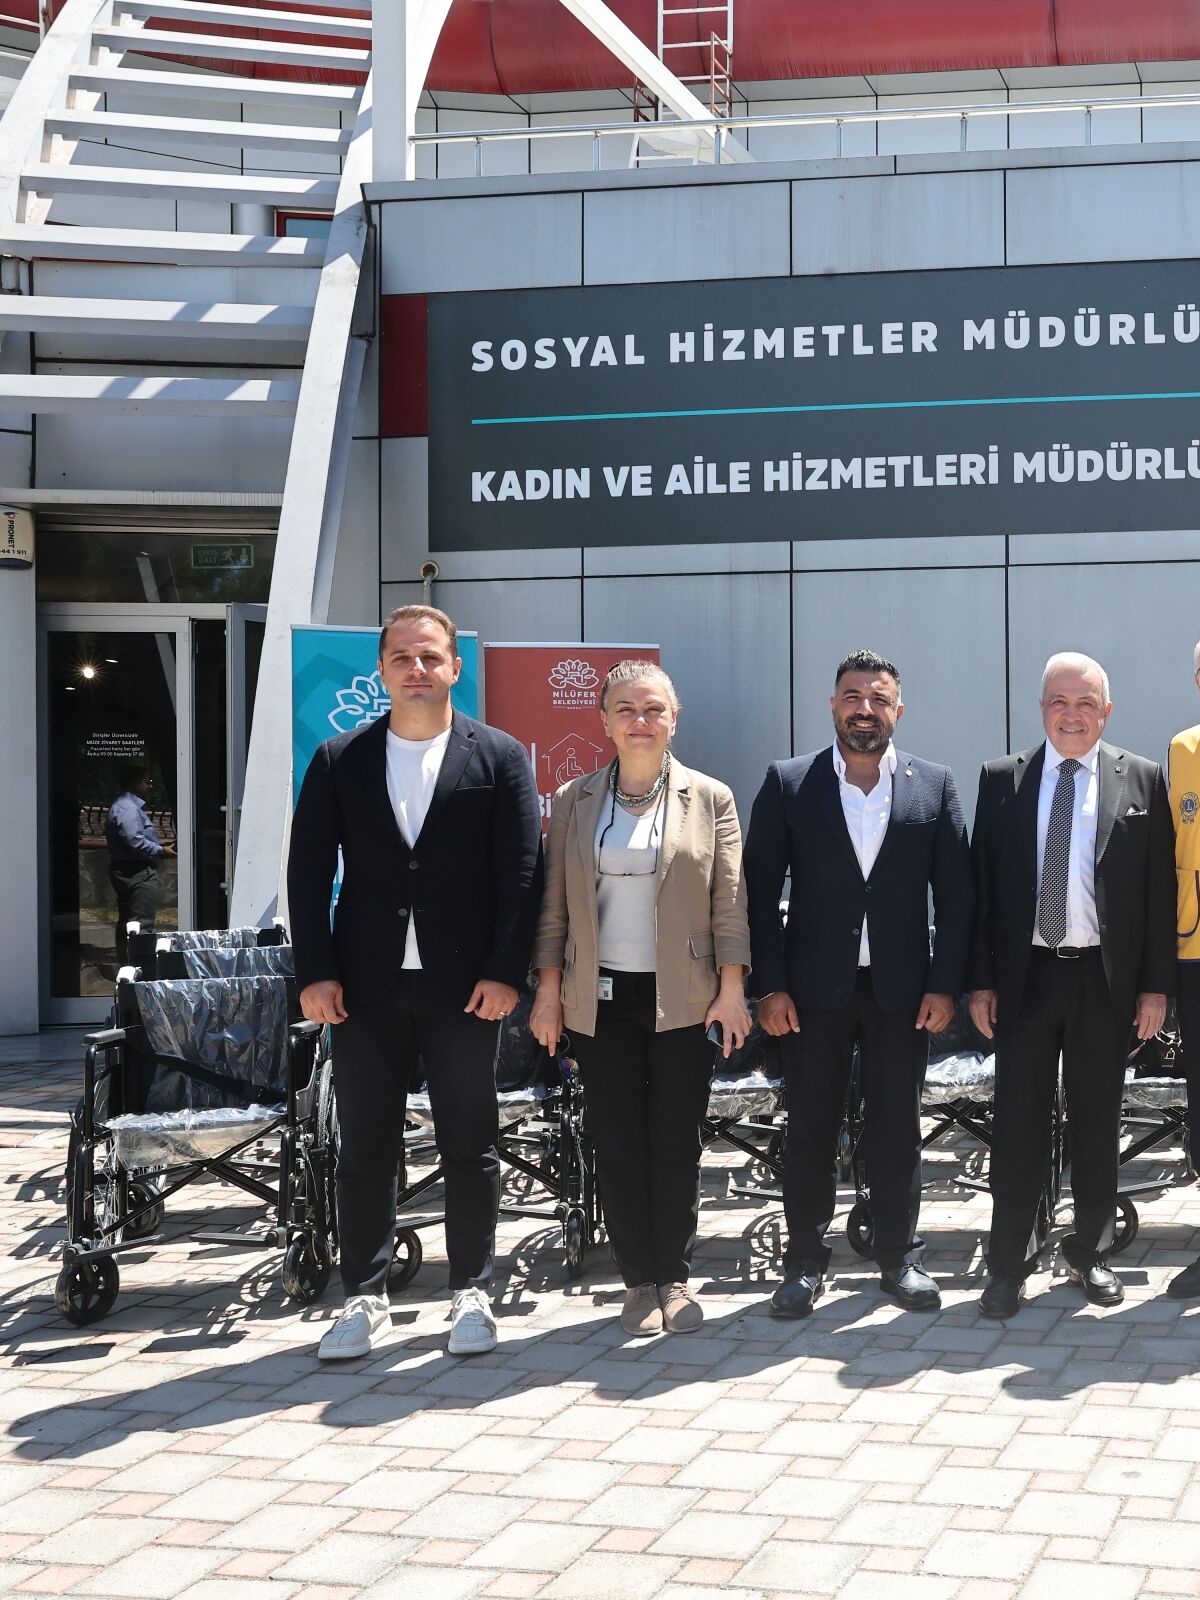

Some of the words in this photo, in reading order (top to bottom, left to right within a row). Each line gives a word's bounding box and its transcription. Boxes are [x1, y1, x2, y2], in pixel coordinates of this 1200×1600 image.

[471, 335, 645, 372] SOSYAL
[669, 321, 938, 363] HİZMETLER
[471, 467, 590, 502] KADIN
[602, 465, 653, 497] VE
[663, 455, 751, 496] AİLE
[763, 444, 999, 492] HİZMETLERİ
[553, 690, 596, 698] NİLÜFER
